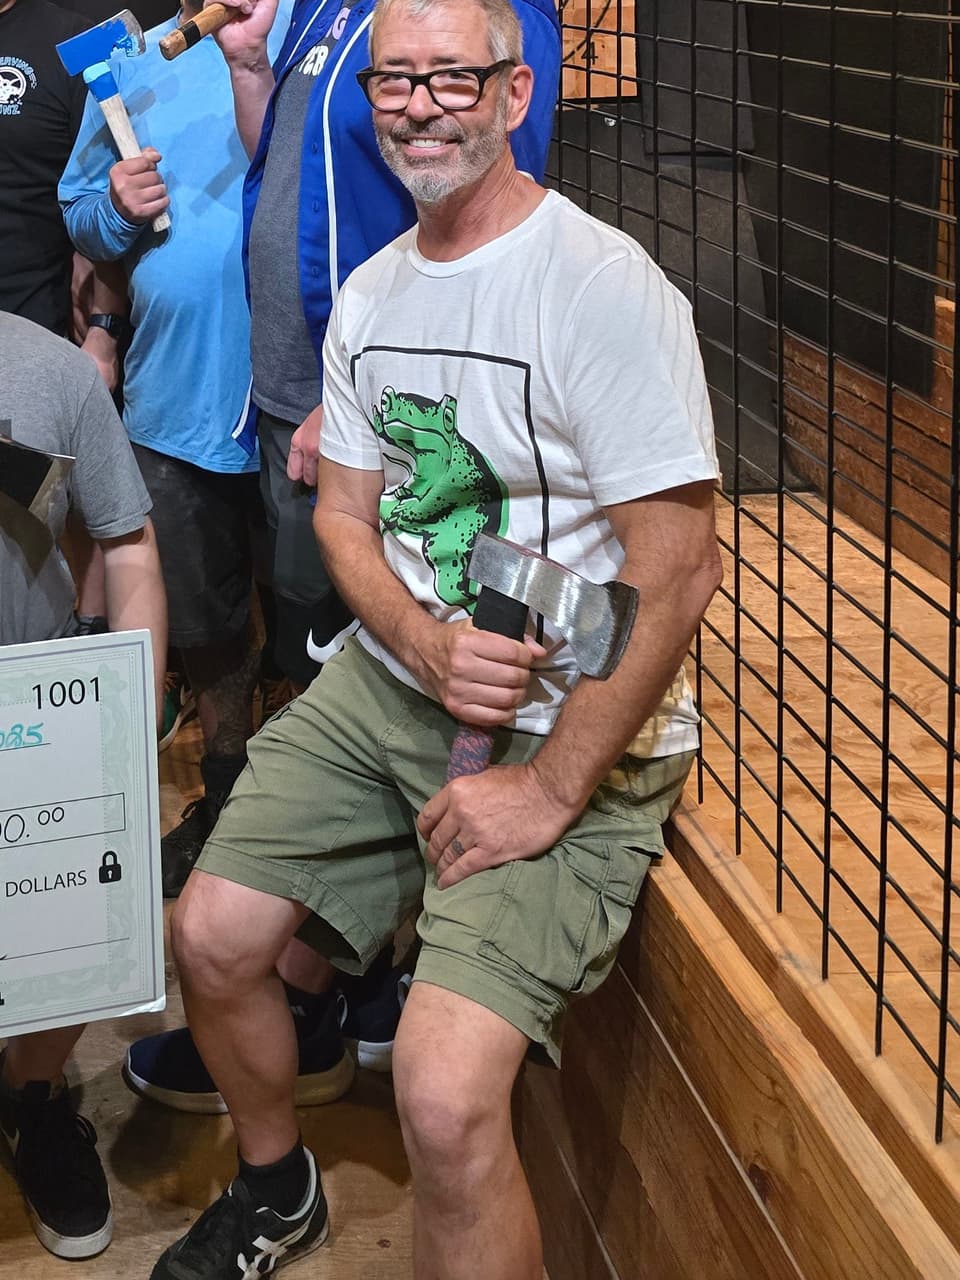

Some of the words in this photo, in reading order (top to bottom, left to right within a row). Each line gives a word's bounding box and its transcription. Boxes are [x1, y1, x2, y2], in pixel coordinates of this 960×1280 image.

[581, 41, 599, 66] 4
[31, 676, 101, 710] 1001
[5, 869, 89, 899] DOLLARS
